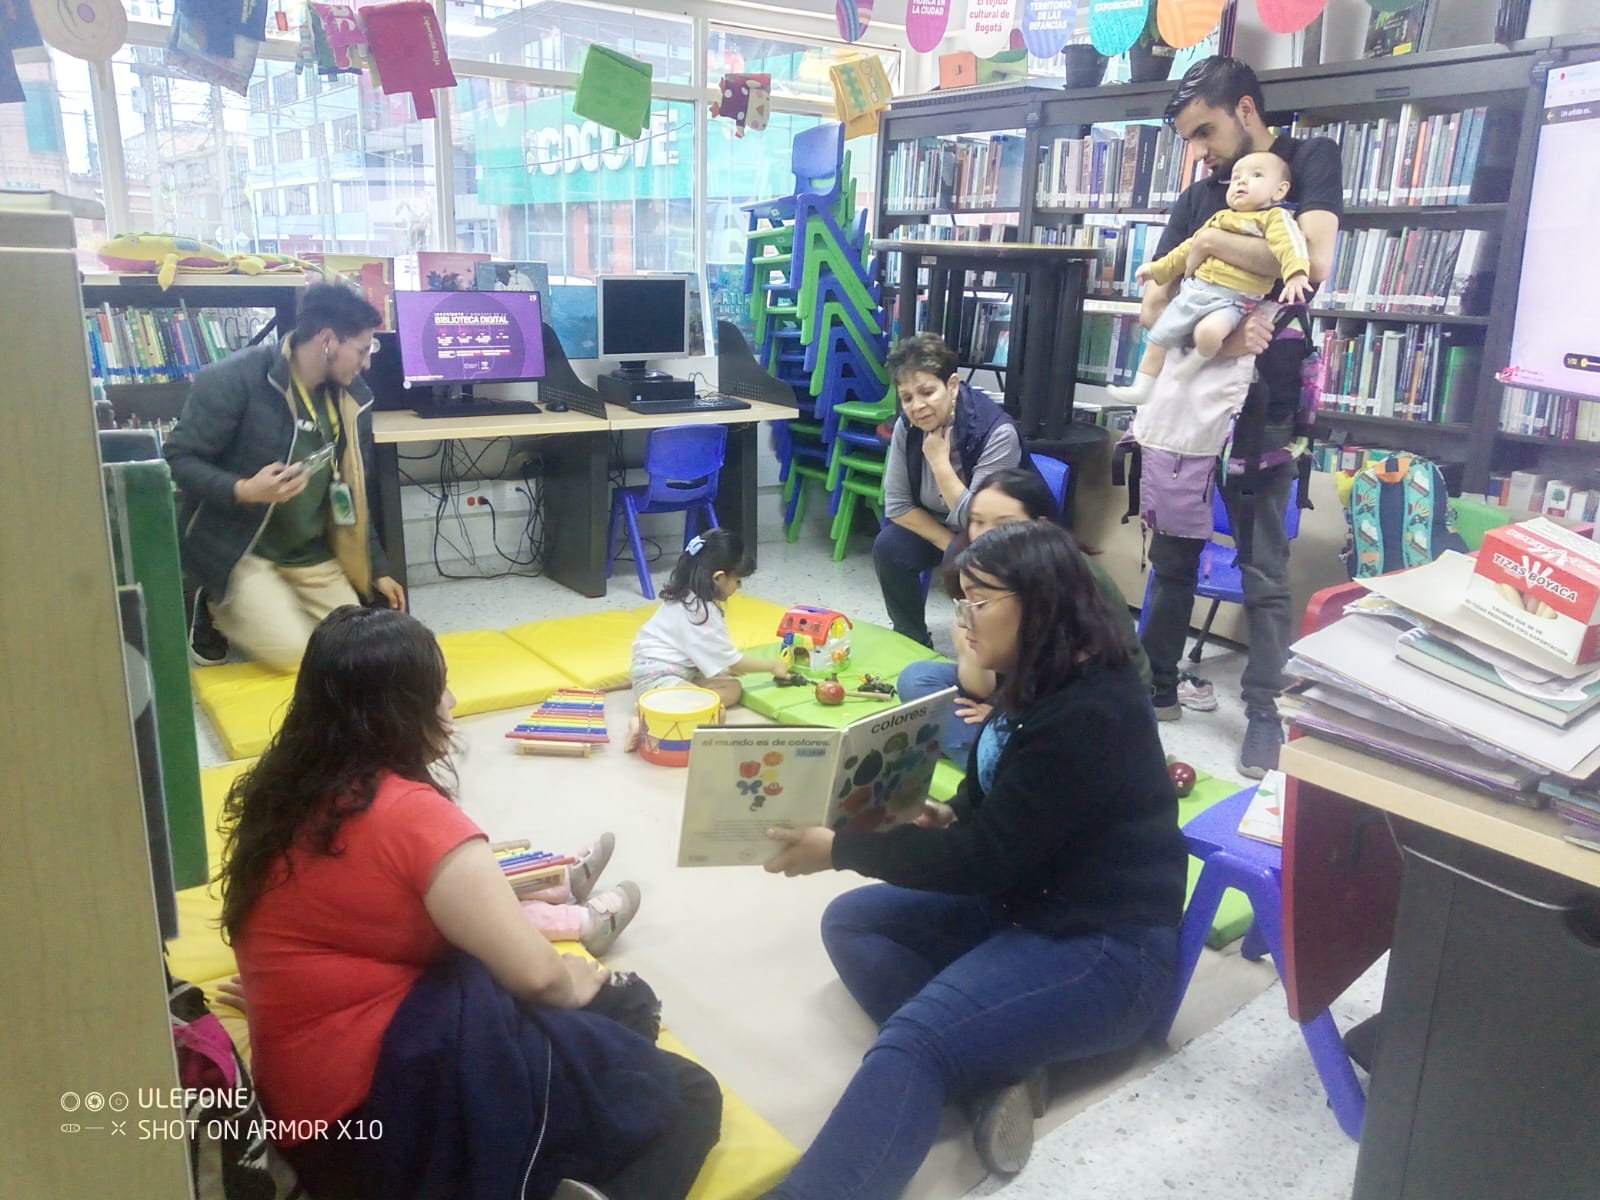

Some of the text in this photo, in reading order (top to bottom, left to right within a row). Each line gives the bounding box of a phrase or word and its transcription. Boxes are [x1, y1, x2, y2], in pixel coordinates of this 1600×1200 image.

[912, 5, 944, 16] LA CIUDAD
[1030, 2, 1072, 11] TERRITORIO
[969, 9, 1010, 19] cultural de
[1037, 10, 1062, 20] DE LAS
[975, 22, 1002, 34] Bogotá
[1029, 21, 1067, 31] INFANCIAS
[434, 315, 509, 324] BIBLIOTECA DIGITAL
[1493, 553, 1577, 601] TIZAS BOYACA
[871, 705, 928, 734] colores
[702, 738, 712, 747] el
[715, 738, 754, 747] mundo
[771, 738, 786, 747] de
